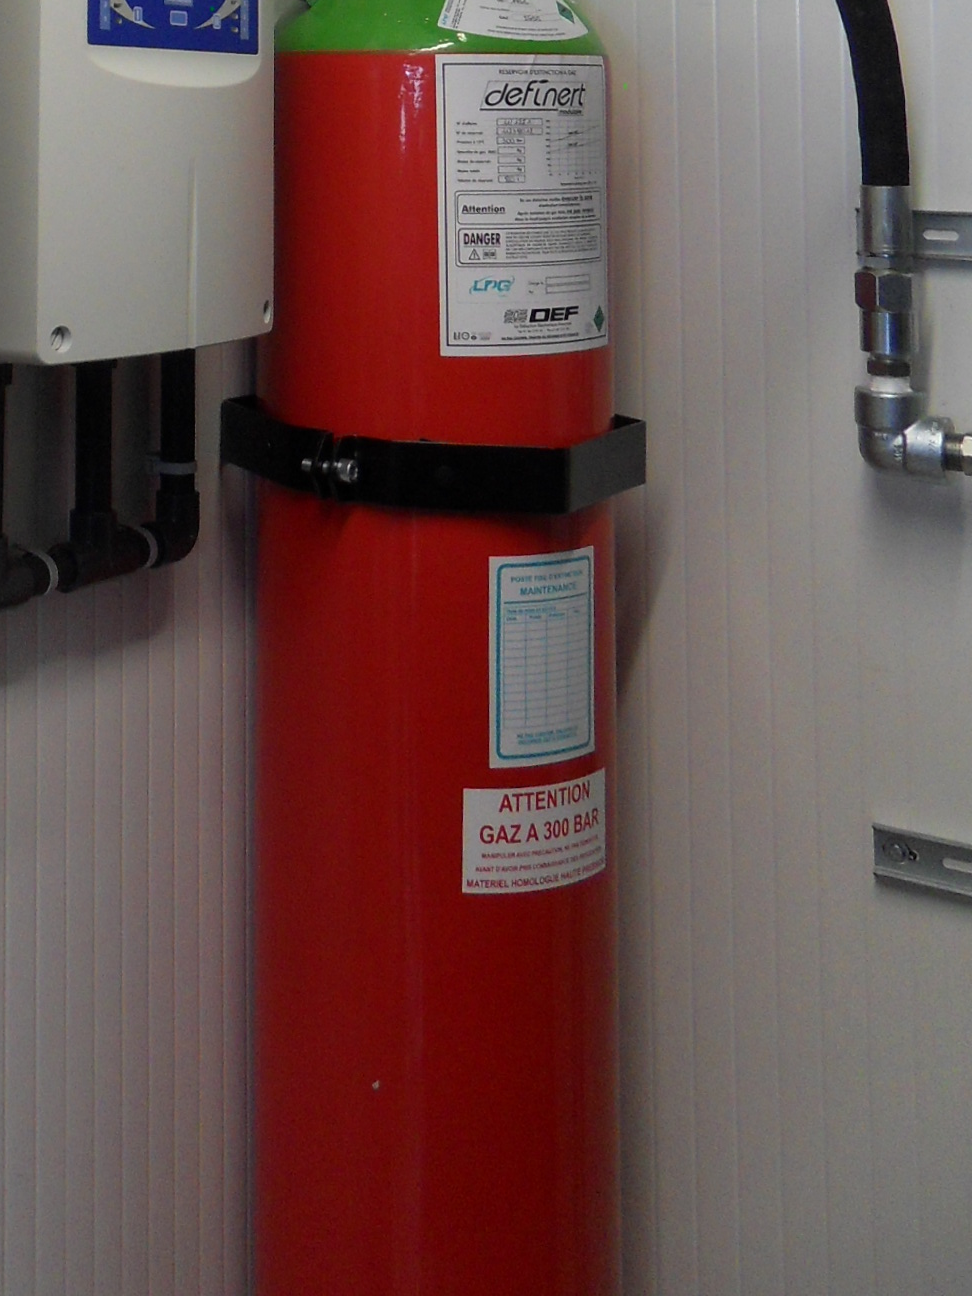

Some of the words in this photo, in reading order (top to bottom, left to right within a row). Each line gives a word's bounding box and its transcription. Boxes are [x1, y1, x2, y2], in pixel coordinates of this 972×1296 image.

[484, 80, 586, 108] definert
[462, 204, 507, 215] Attention
[463, 233, 501, 247] DANGER
[471, 277, 514, 294] LPG
[529, 306, 579, 323] DEF
[520, 582, 578, 596] MAINTENANCE
[499, 780, 591, 813] ATTENTION
[479, 824, 521, 845] GAZ
[526, 822, 539, 843] A
[544, 818, 569, 840] 300
[574, 808, 599, 834] BAR
[466, 878, 509, 889] MATERIEL
[511, 869, 559, 888] HOMOLOGUE
